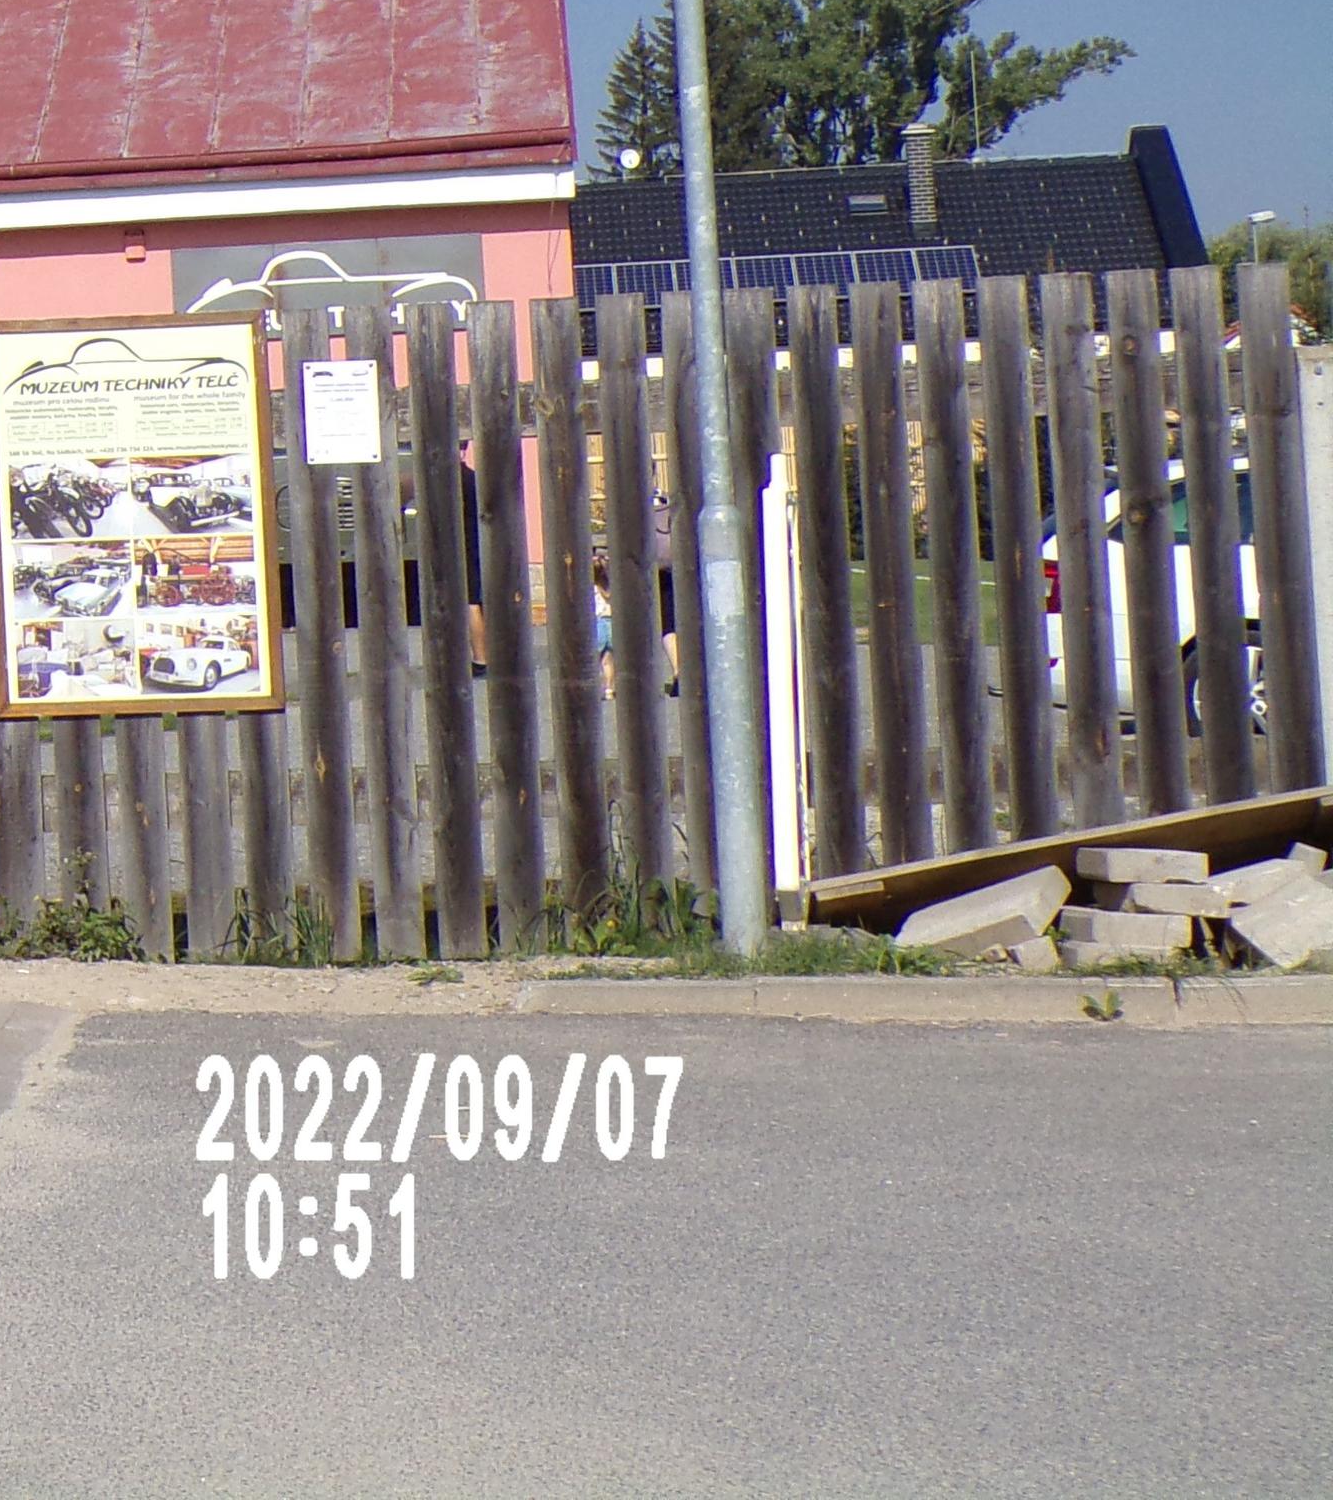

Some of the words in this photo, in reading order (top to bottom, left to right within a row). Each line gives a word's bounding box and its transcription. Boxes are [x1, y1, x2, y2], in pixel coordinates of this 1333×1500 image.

[20, 380, 99, 395] MUZEUM
[103, 376, 191, 392] TECHNIKY
[195, 372, 240, 388] TELČ
